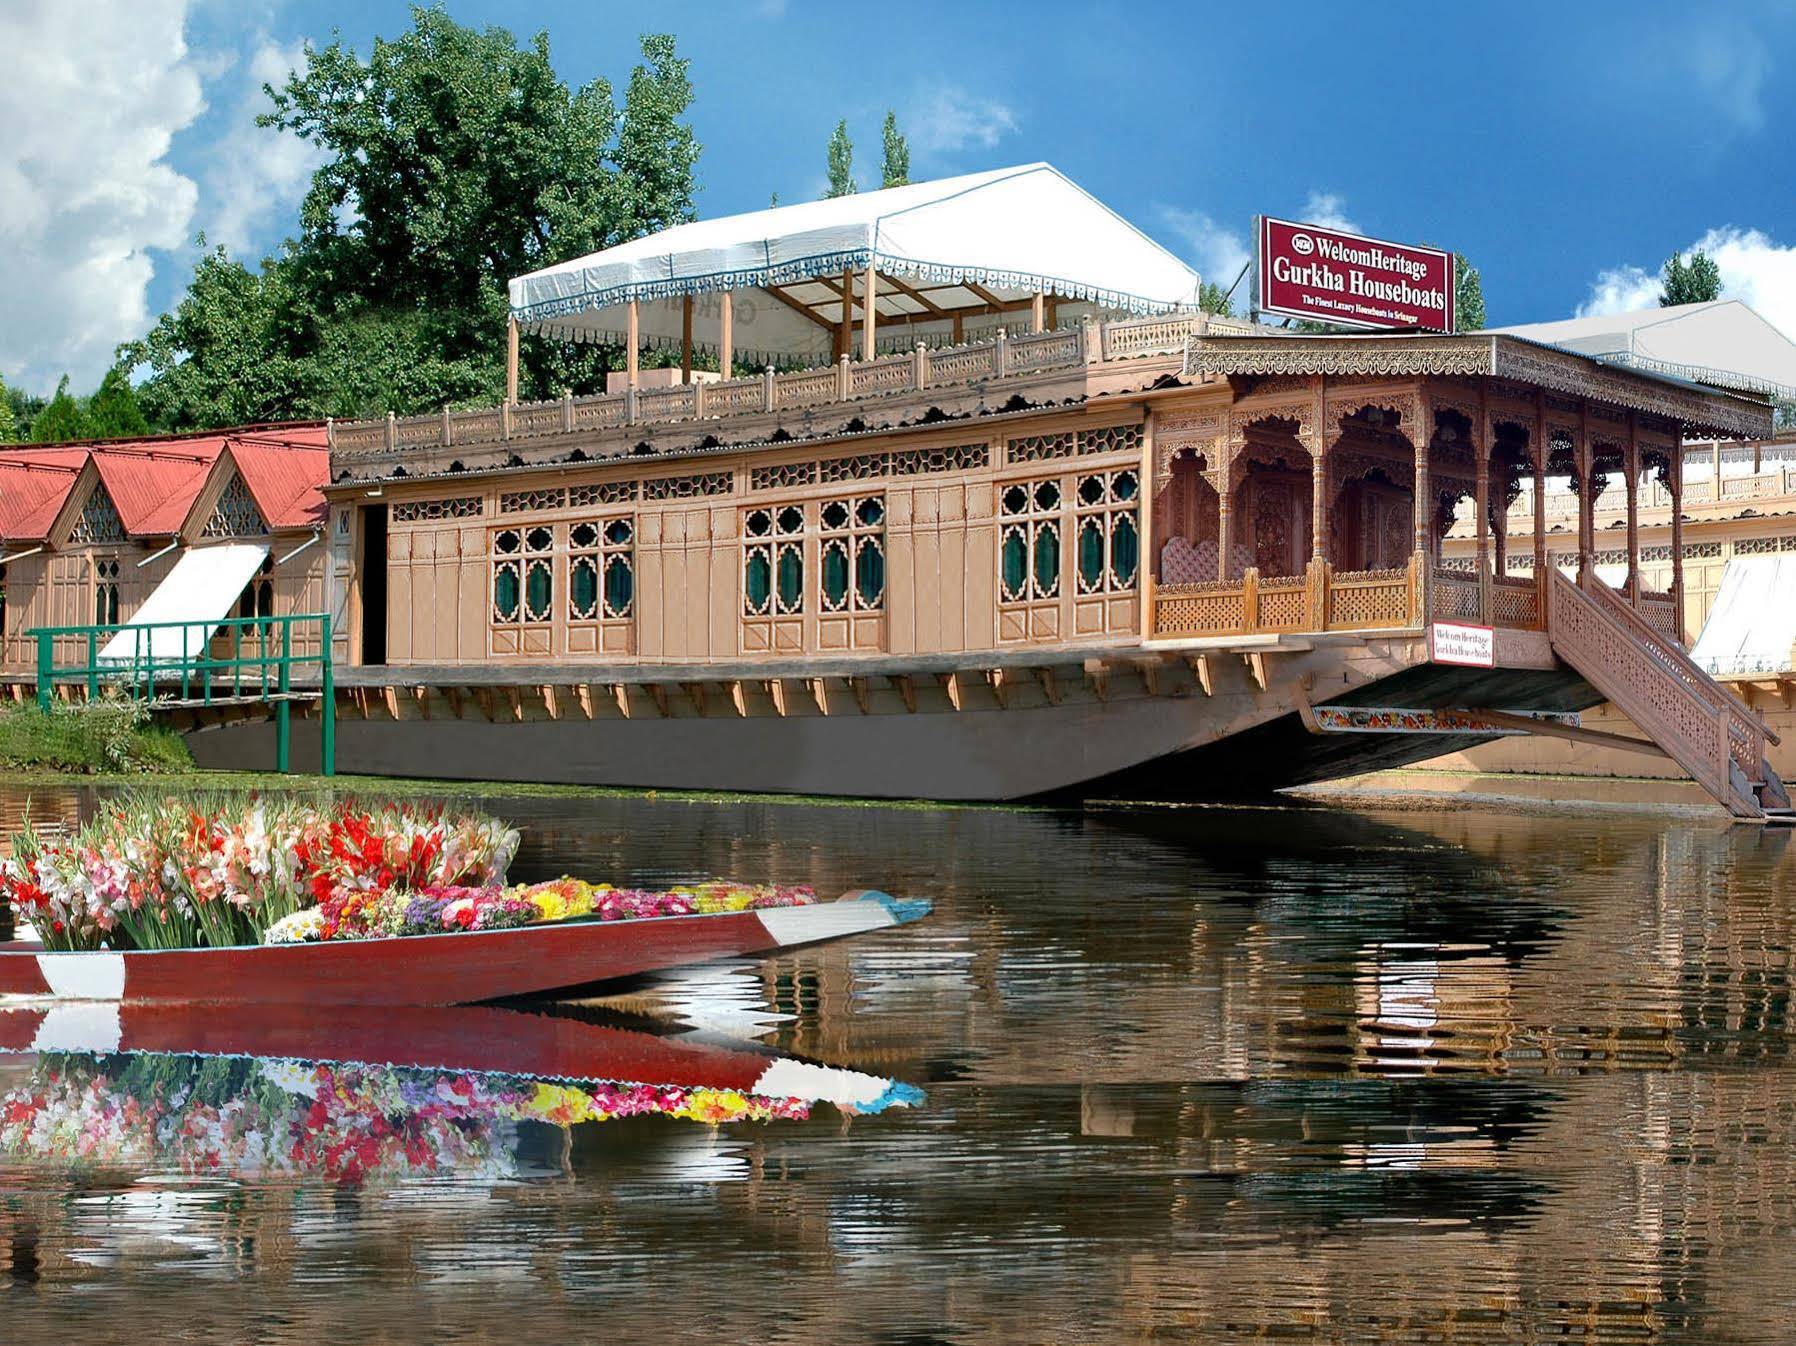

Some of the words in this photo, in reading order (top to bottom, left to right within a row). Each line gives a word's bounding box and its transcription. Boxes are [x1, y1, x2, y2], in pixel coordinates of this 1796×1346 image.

[1316, 237, 1427, 280] WelcomHeritage
[1273, 256, 1344, 292] Gurkha
[1349, 269, 1445, 310] Houseboats
[1302, 294, 1314, 305] The
[1315, 296, 1333, 308] Finest
